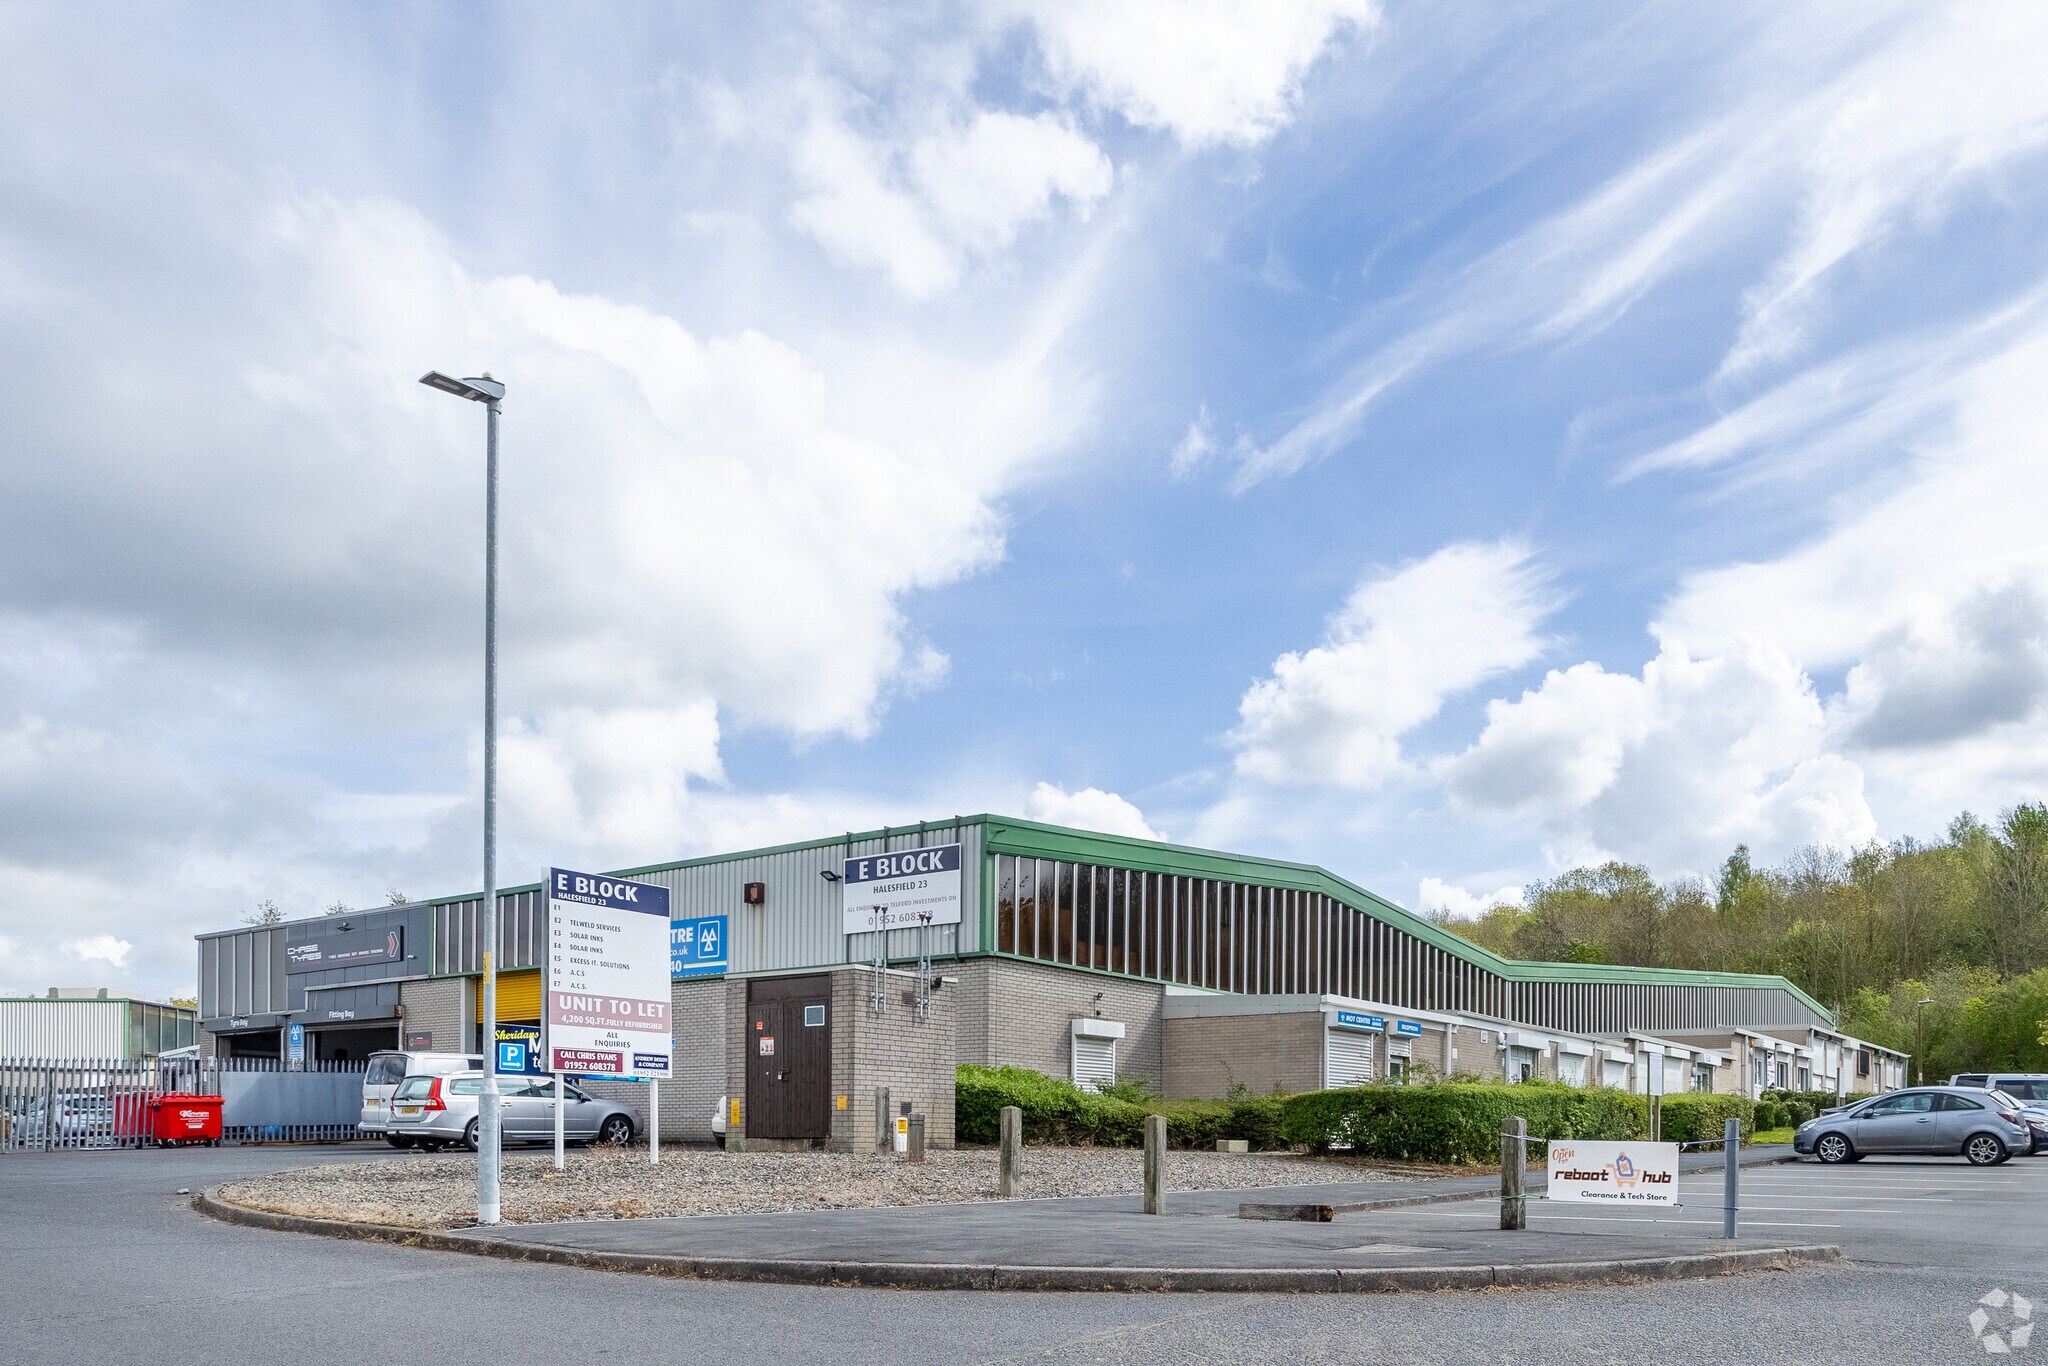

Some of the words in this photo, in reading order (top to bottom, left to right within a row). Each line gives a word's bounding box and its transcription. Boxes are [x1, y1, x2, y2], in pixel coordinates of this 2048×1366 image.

[859, 861, 869, 880] E
[876, 850, 944, 877] BLOCK
[557, 873, 568, 890] E
[575, 876, 639, 902] BLOCK
[873, 881, 916, 894] HALESFIELD
[918, 880, 928, 889] 23
[558, 892, 596, 904] HALESFIELD
[597, 898, 607, 906] 23
[890, 900, 911, 908] TELFORD
[912, 896, 947, 905] INVESTMENTS
[570, 919, 595, 929] TELWELD
[596, 923, 621, 933] SERVICES
[868, 914, 896, 926] 0952
[570, 931, 589, 940] SOLAR
[569, 944, 588, 952] SOLAR
[589, 946, 603, 954] INKS
[570, 957, 590, 966] EXCESS
[600, 961, 630, 970] SOLUTIONS
[560, 994, 603, 1013] UNIT
[609, 999, 632, 1015] TO
[638, 1002, 665, 1018] LET
[329, 1010, 344, 1019] Fitting
[345, 1010, 355, 1019] Bay
[230, 1020, 239, 1028] Tyre
[240, 1019, 248, 1027] Bay
[561, 1015, 583, 1024] 4,200
[625, 1021, 663, 1030] REFURBISHED
[495, 1029, 539, 1040] Sheridans
[594, 1040, 631, 1048] ENQUIRIES
[507, 1046, 518, 1061] P
[560, 1051, 576, 1059] CALL
[577, 1051, 595, 1060] CHRIS
[597, 1053, 617, 1061] EVANS
[564, 1061, 587, 1070] 01952
[589, 1062, 616, 1071] 608378
[1552, 1149, 1575, 1163] Open
[1554, 1168, 1609, 1182] reboot
[1642, 1170, 1672, 1183] hub
[1581, 1190, 1618, 1199] Clearance
[1627, 1192, 1645, 1200] Tech
[1646, 1193, 1668, 1201] Store
